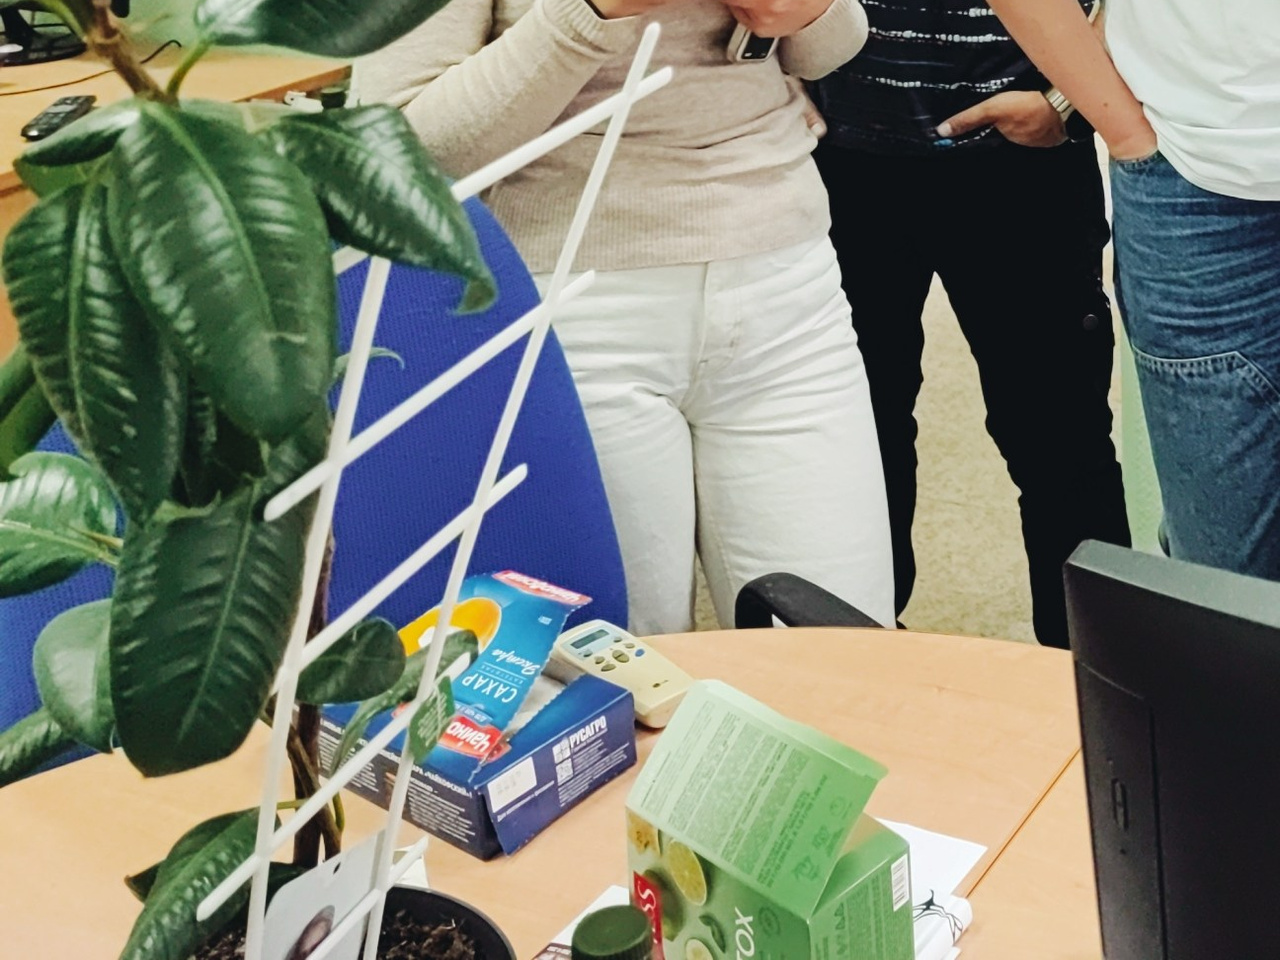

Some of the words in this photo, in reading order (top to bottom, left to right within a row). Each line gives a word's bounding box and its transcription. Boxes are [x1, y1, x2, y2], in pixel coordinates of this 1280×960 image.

[491, 648, 541, 676] Экстра
[461, 672, 518, 704] САХАР
[446, 721, 492, 754] Чайко
[569, 715, 607, 748] РУСАГРО
